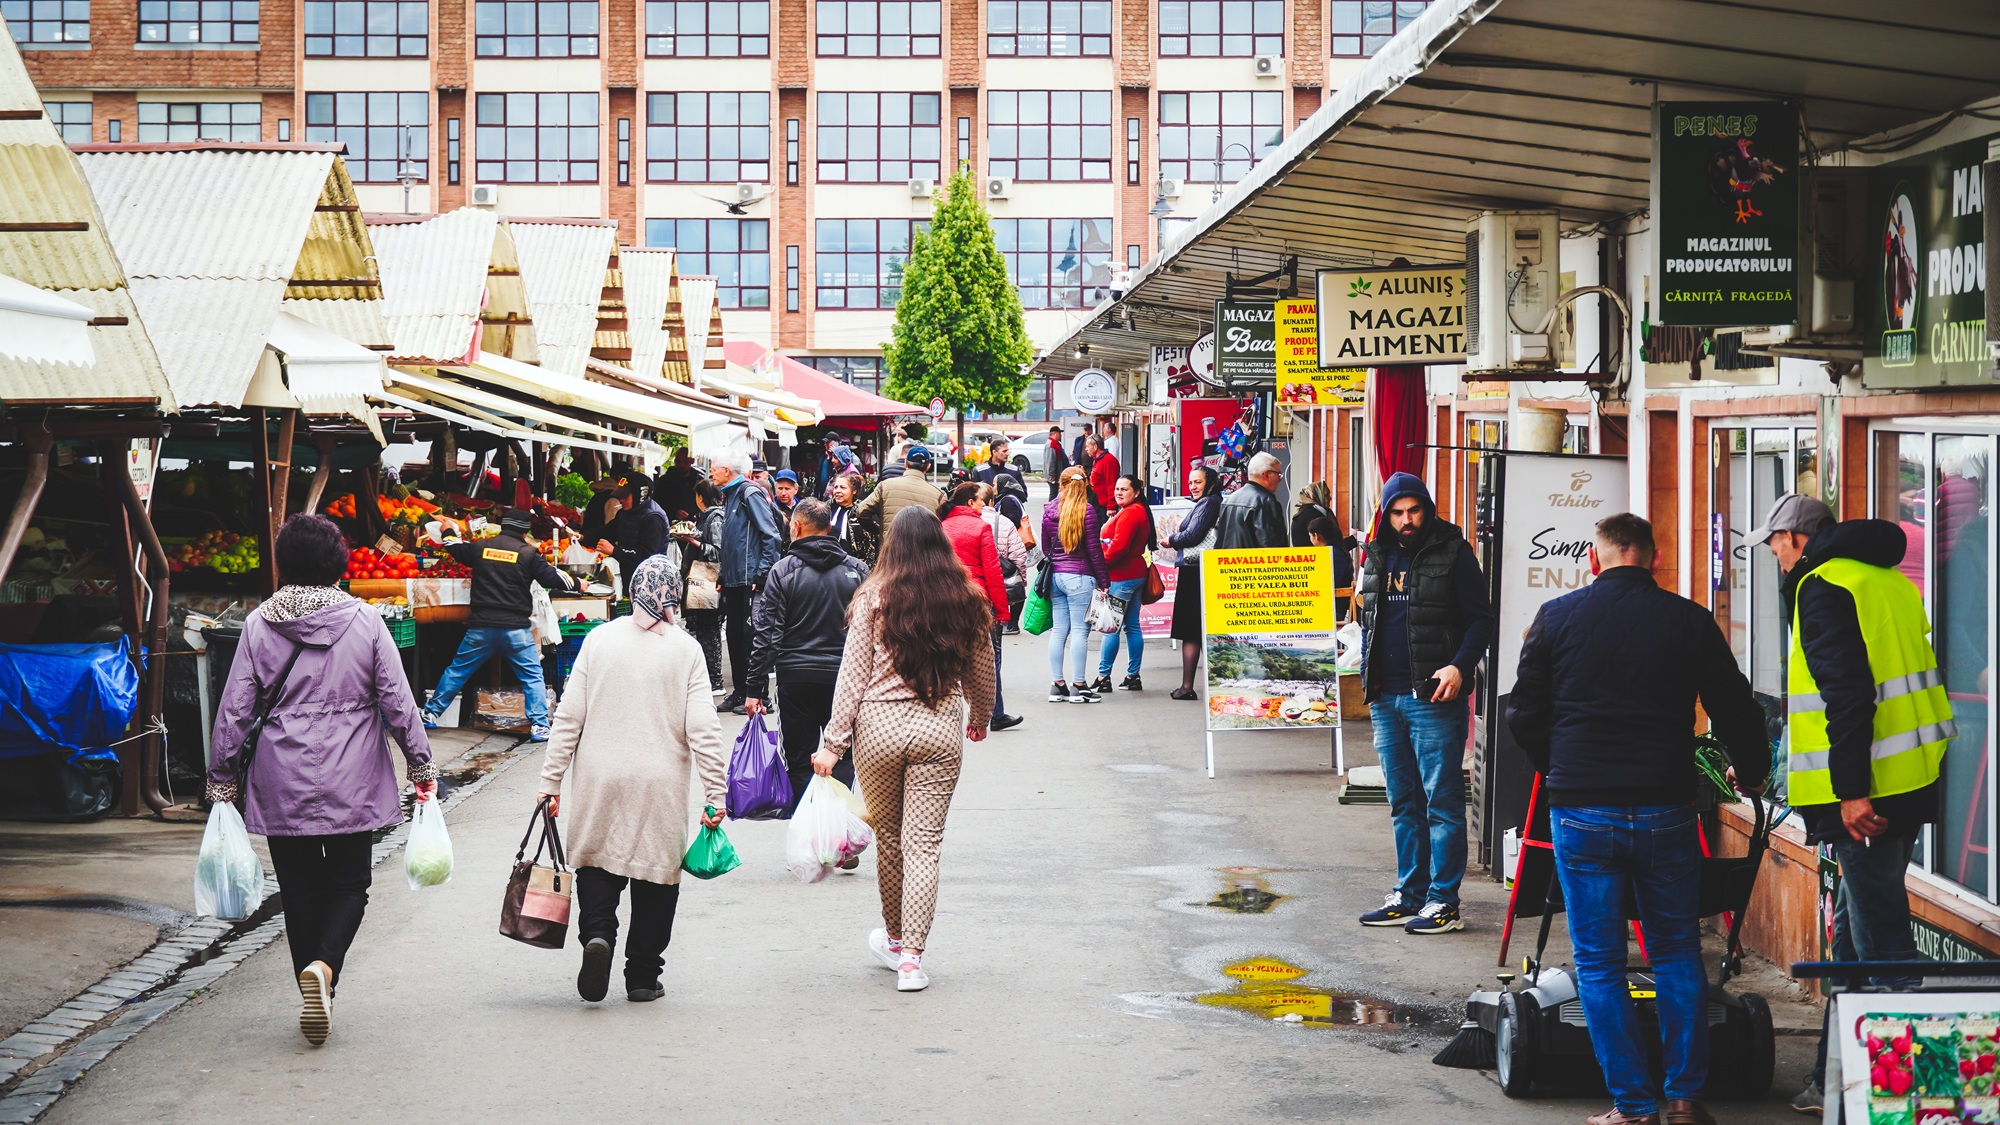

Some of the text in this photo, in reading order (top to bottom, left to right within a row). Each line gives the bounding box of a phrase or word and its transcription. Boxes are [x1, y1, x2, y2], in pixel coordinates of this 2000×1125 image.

[1952, 164, 1985, 218] MA
[1687, 237, 1772, 252] MAGAZINUL
[1666, 258, 1792, 273] PRODUCATORULUI
[1665, 289, 1793, 304] CĂRNIȚĂ FRAGEDĂ
[1349, 306, 1467, 331] MAGAZI
[1293, 347, 1305, 356] DE
[1548, 493, 1604, 508] Tchibo
[1218, 554, 1316, 566] PRAVALIA LU' SABAU
[1254, 566, 1302, 574] TRADITIONALE
[1252, 591, 1285, 599] LACTATE
[1295, 590, 1320, 598] CARNE
[1910, 920, 1940, 961] ARNE
